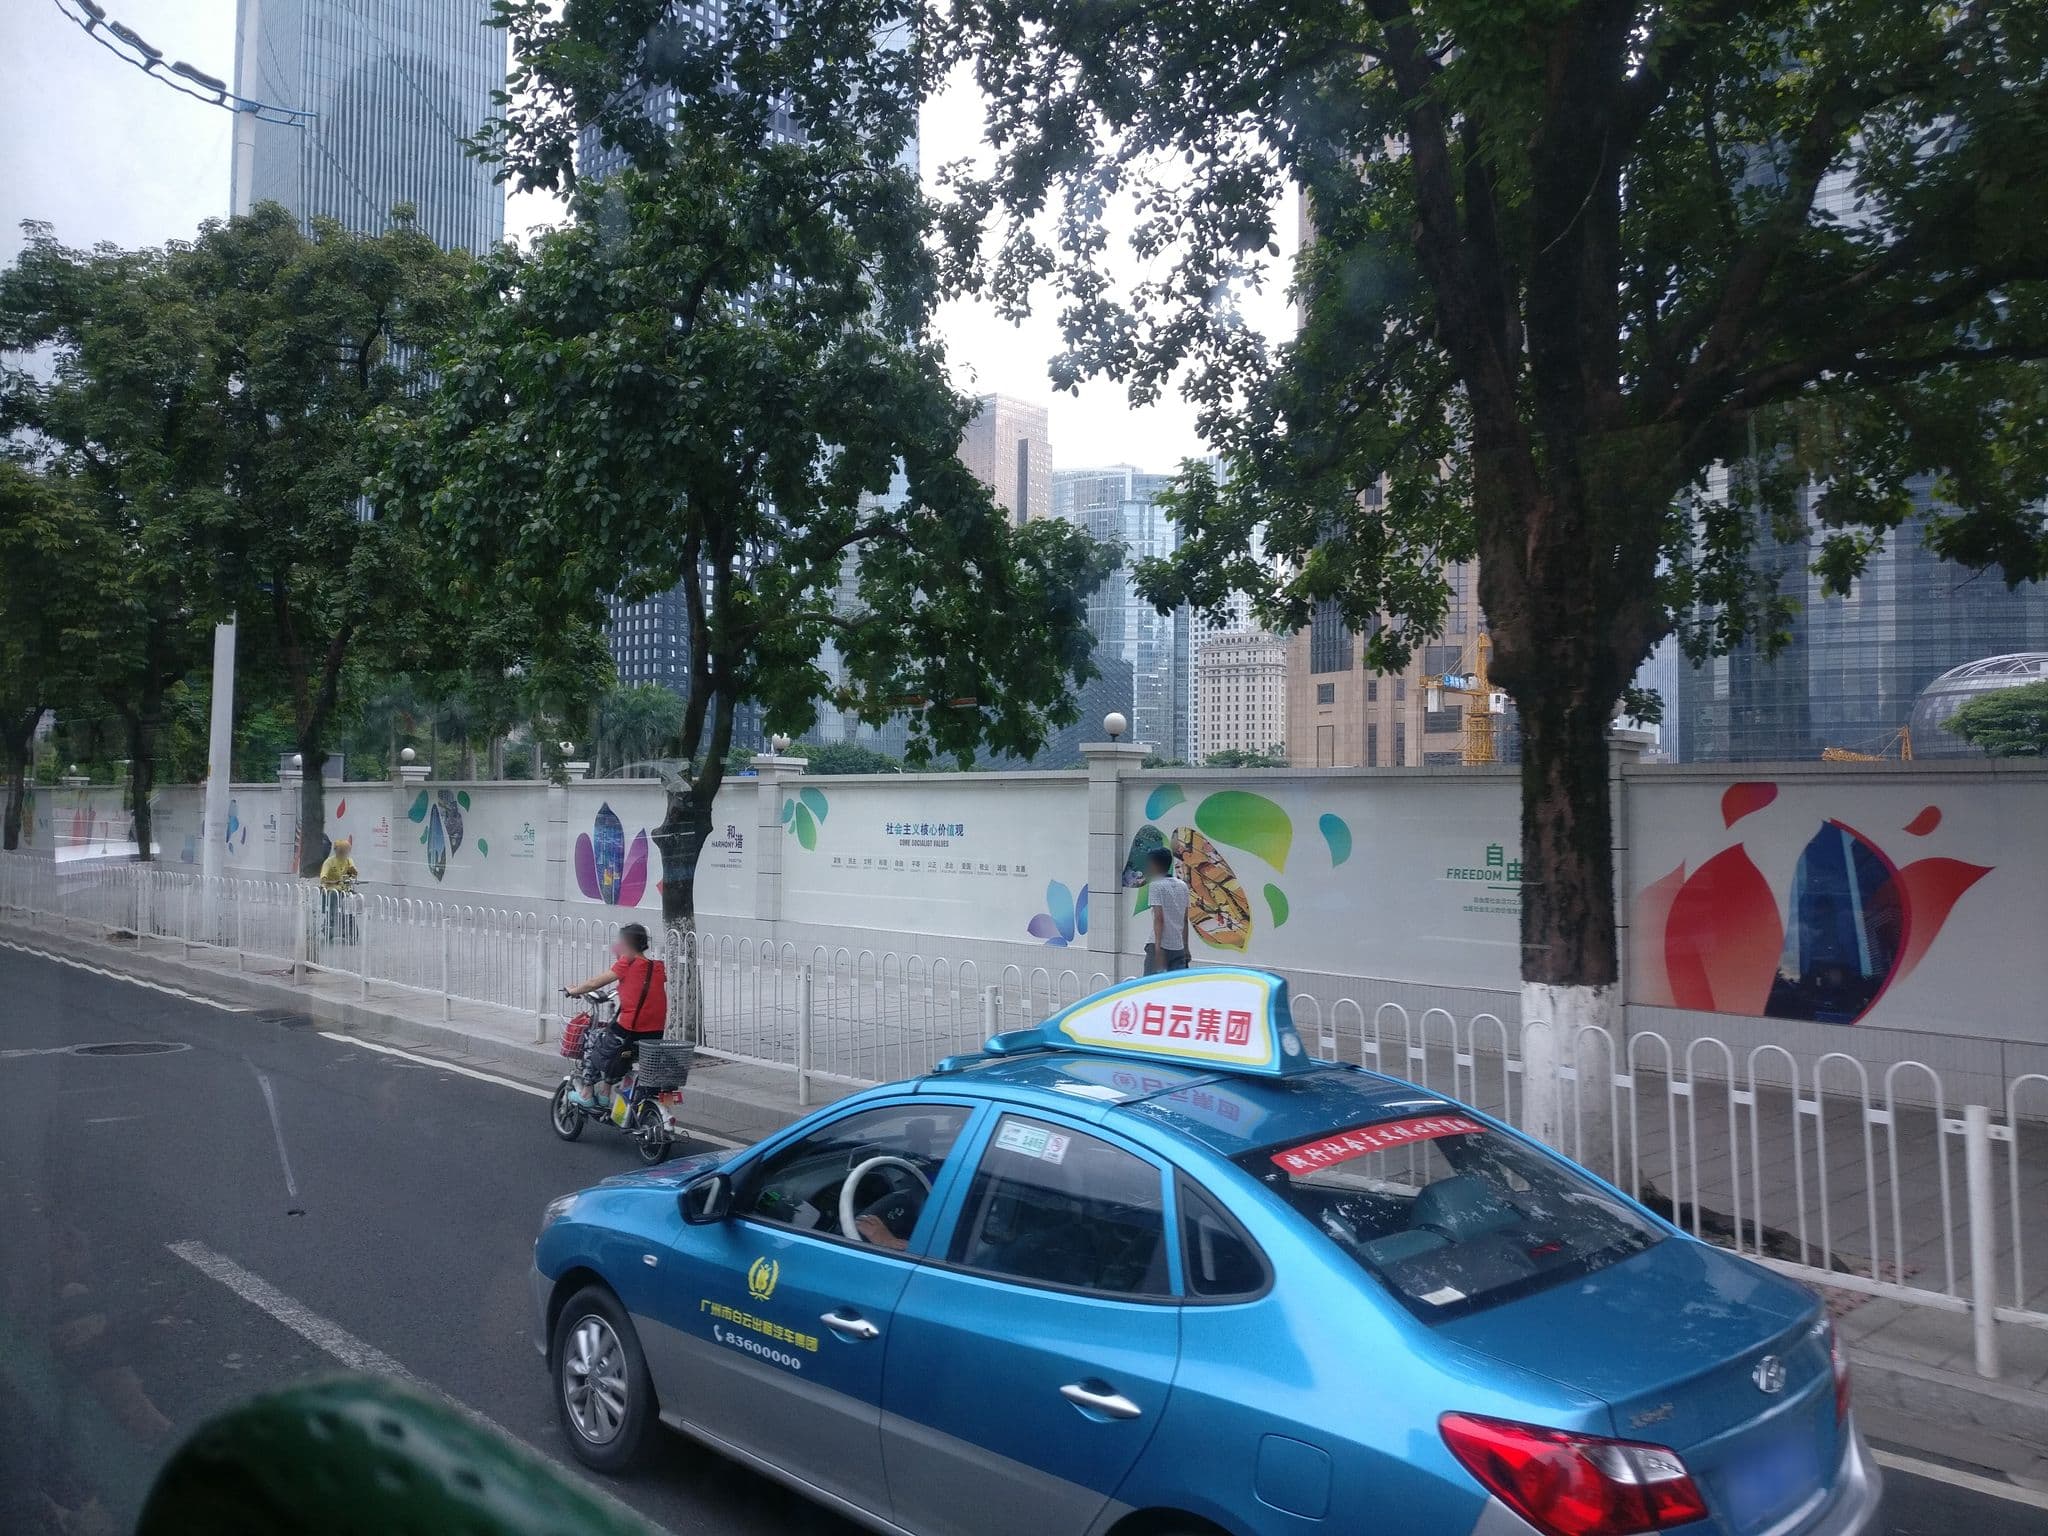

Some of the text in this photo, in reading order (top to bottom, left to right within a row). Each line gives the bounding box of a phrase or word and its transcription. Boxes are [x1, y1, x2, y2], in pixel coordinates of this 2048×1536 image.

[886, 822, 965, 837] 社会主义核心价值观
[1446, 868, 1503, 881] FREEDOM
[1142, 1002, 1253, 1046] 白云集团
[725, 1332, 801, 1370] 83600000
